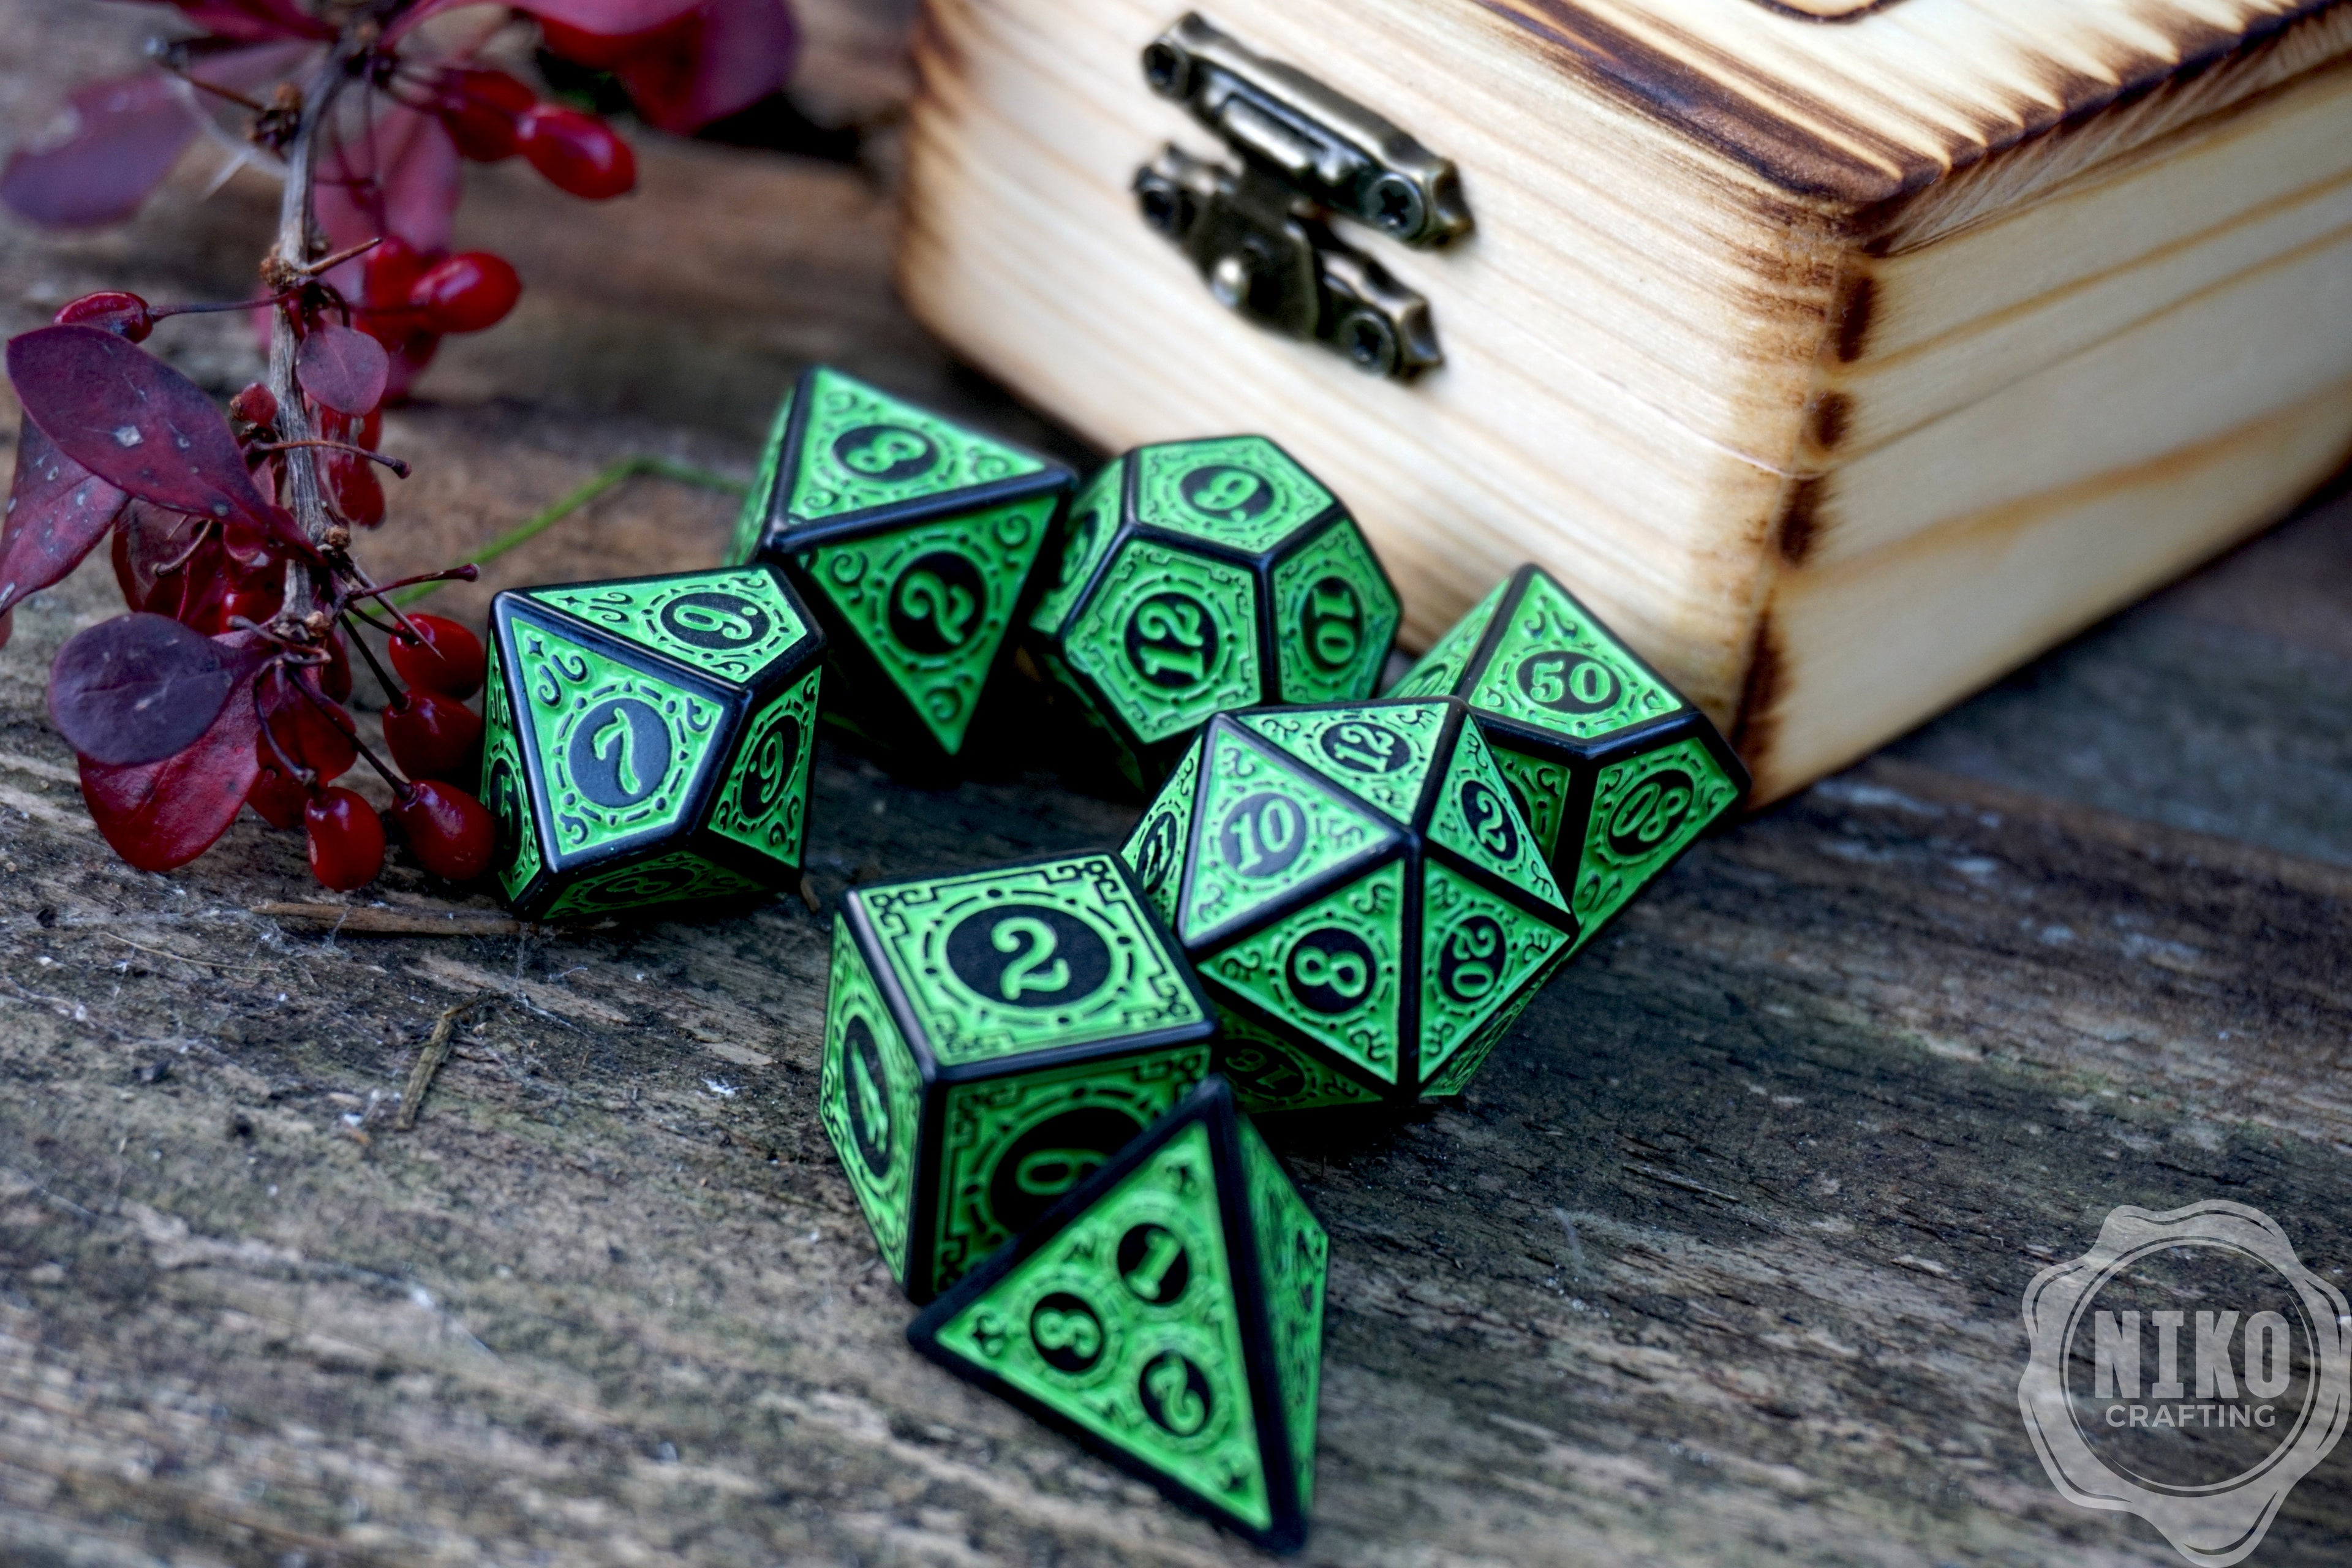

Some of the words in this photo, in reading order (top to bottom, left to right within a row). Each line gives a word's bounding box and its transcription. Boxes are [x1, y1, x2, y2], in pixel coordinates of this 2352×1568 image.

[902, 571, 975, 644] 2
[1136, 601, 1204, 679] 12
[1311, 587, 1355, 665] 10
[1531, 661, 1611, 704] 50
[593, 707, 641, 795] 7
[1333, 725, 1393, 773] 12
[1229, 799, 1295, 870] 10
[1476, 790, 1507, 853] 2
[992, 917, 1071, 1000] 2
[1294, 946, 1366, 997] 8
[1452, 924, 1496, 997] 20
[1126, 1229, 1180, 1300] 1
[1035, 1306, 1100, 1358] 3
[1147, 1353, 1205, 1434] 2
